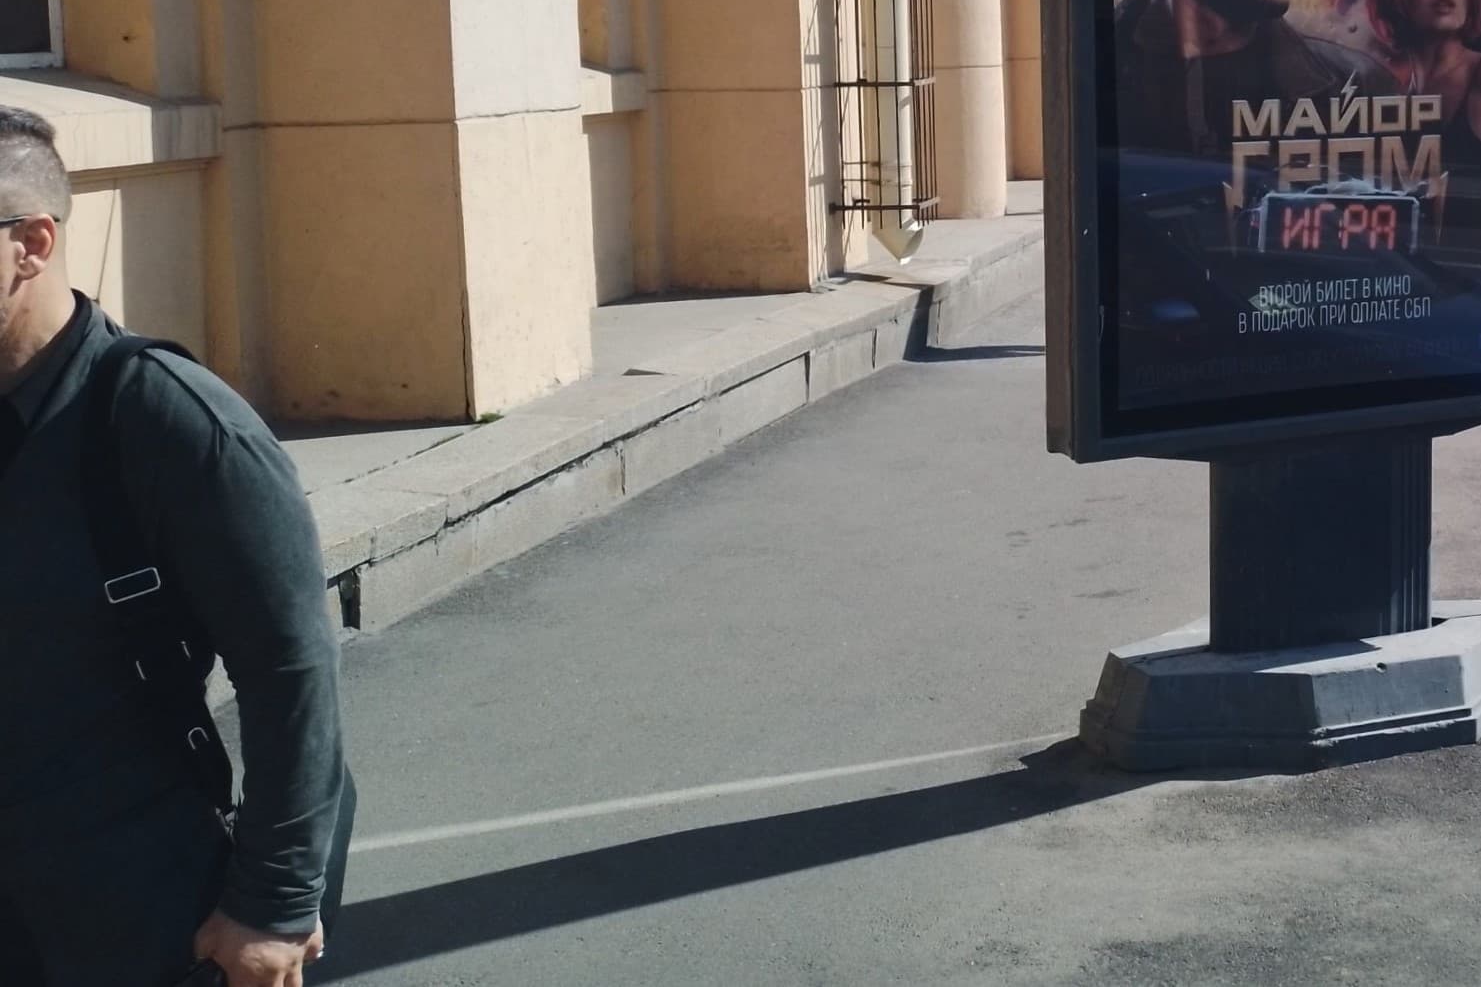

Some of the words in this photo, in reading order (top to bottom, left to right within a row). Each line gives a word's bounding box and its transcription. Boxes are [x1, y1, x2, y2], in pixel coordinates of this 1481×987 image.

[1232, 82, 1442, 137] МАЙОР
[1230, 134, 1444, 203] ГРОМ
[1259, 279, 1312, 308] ВТОРОЙ
[1316, 278, 1358, 303] БИЛЕТ
[1362, 277, 1371, 299] В
[1375, 274, 1411, 297] КИНО
[1238, 312, 1247, 334] В
[1252, 307, 1315, 333] ПОДАРОК
[1320, 303, 1346, 326] ПРИ
[1350, 298, 1400, 324] ОПЛАТЕ
[1404, 296, 1431, 319] СБП
